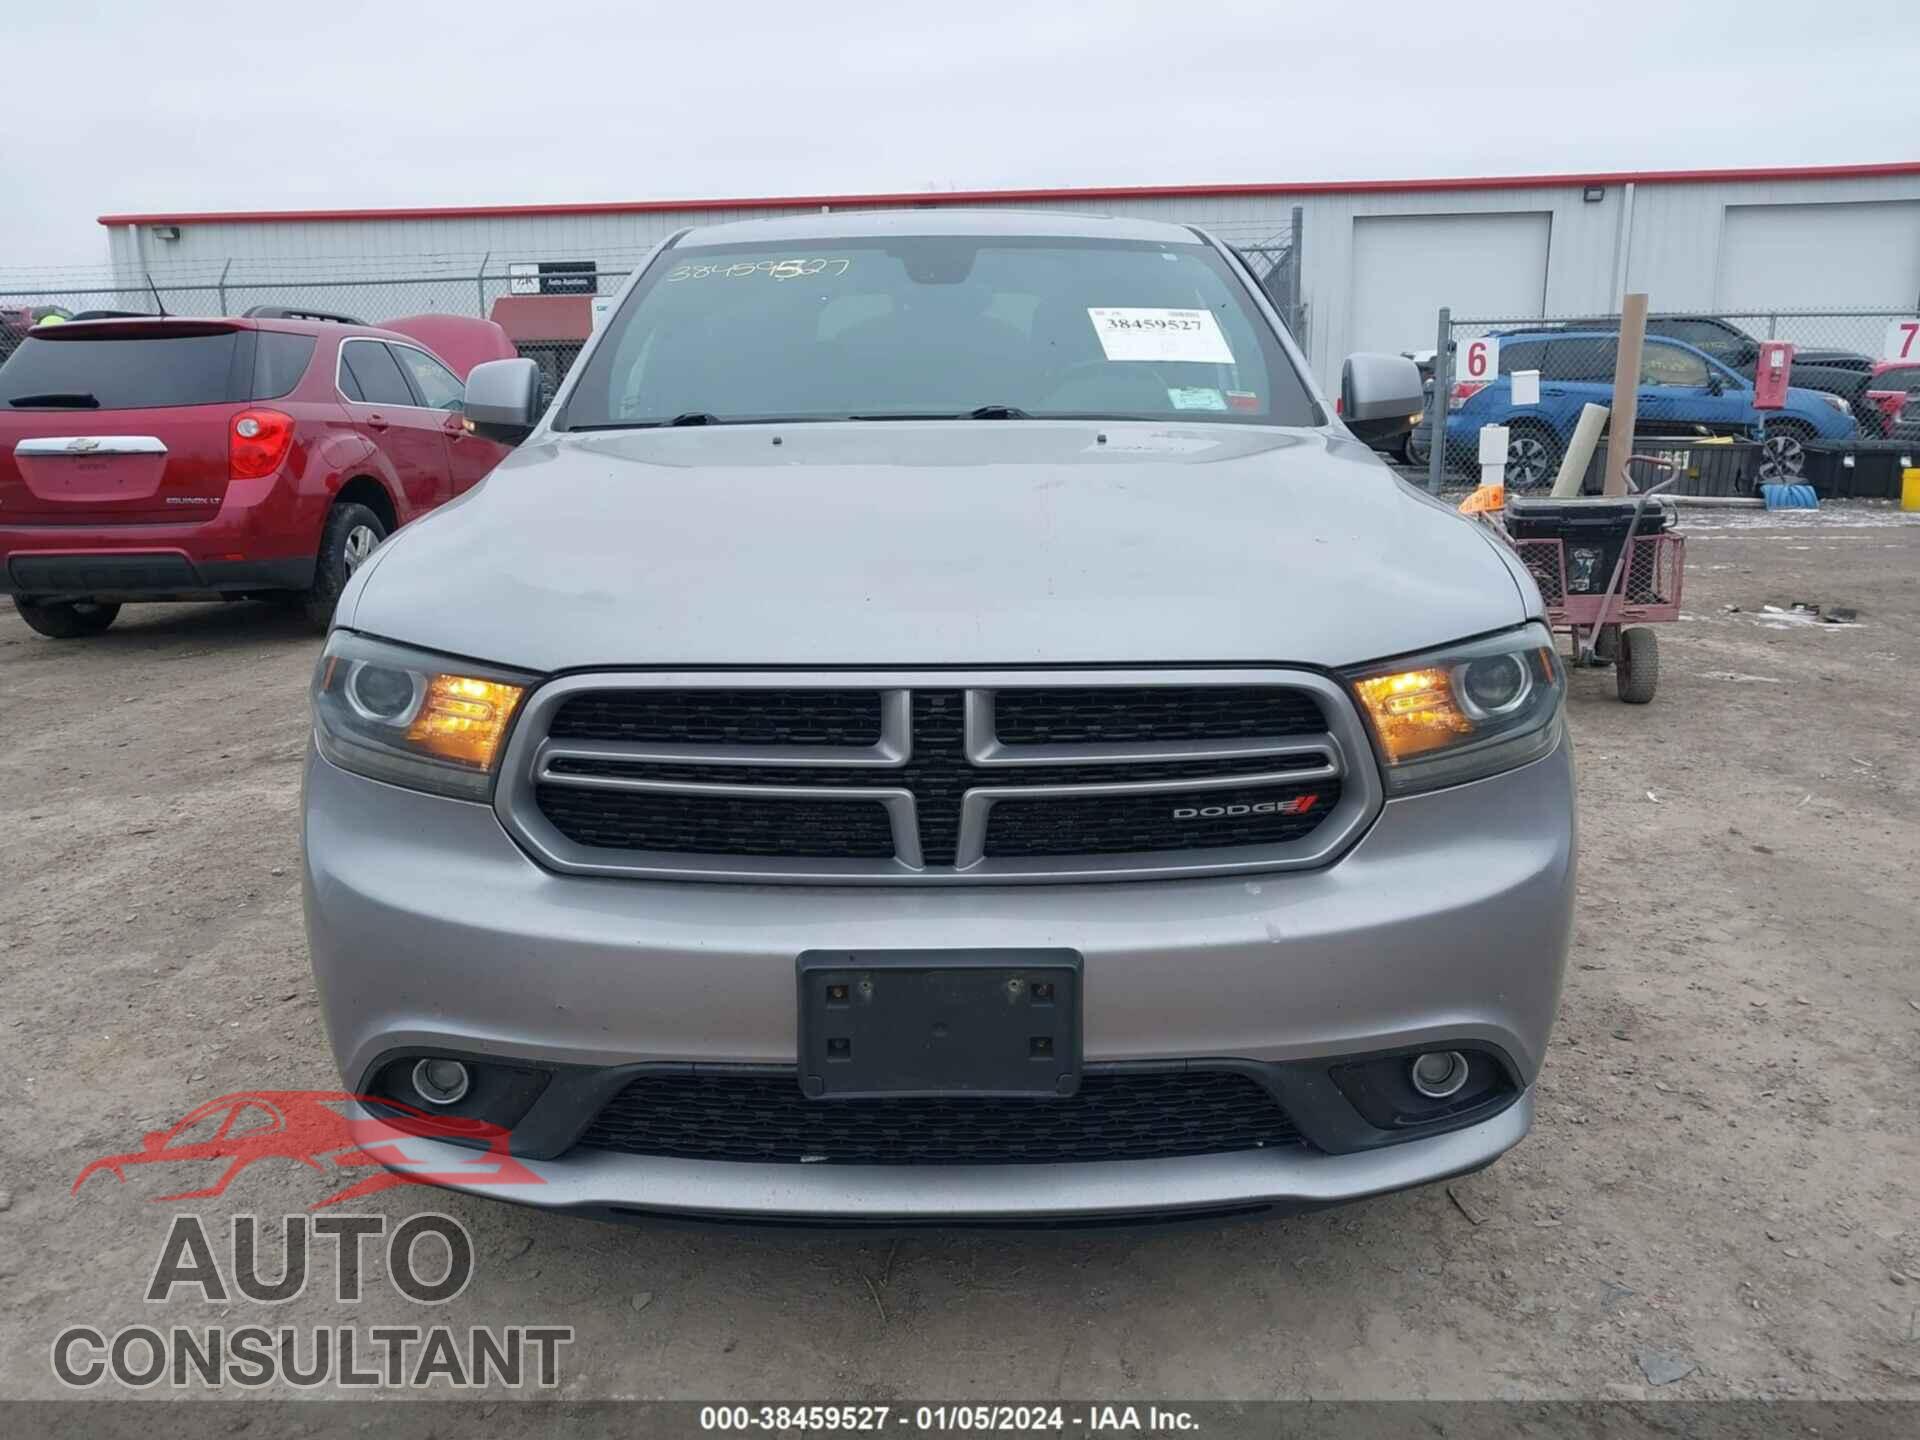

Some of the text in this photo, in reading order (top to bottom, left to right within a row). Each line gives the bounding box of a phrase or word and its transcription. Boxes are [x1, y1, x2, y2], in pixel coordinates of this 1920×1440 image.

[667, 259, 850, 282] 38459527
[1107, 319, 1201, 331] 38459527
[1900, 323, 1919, 358] 7
[1468, 342, 1487, 377] 6
[1173, 799, 1298, 819] DODGE
